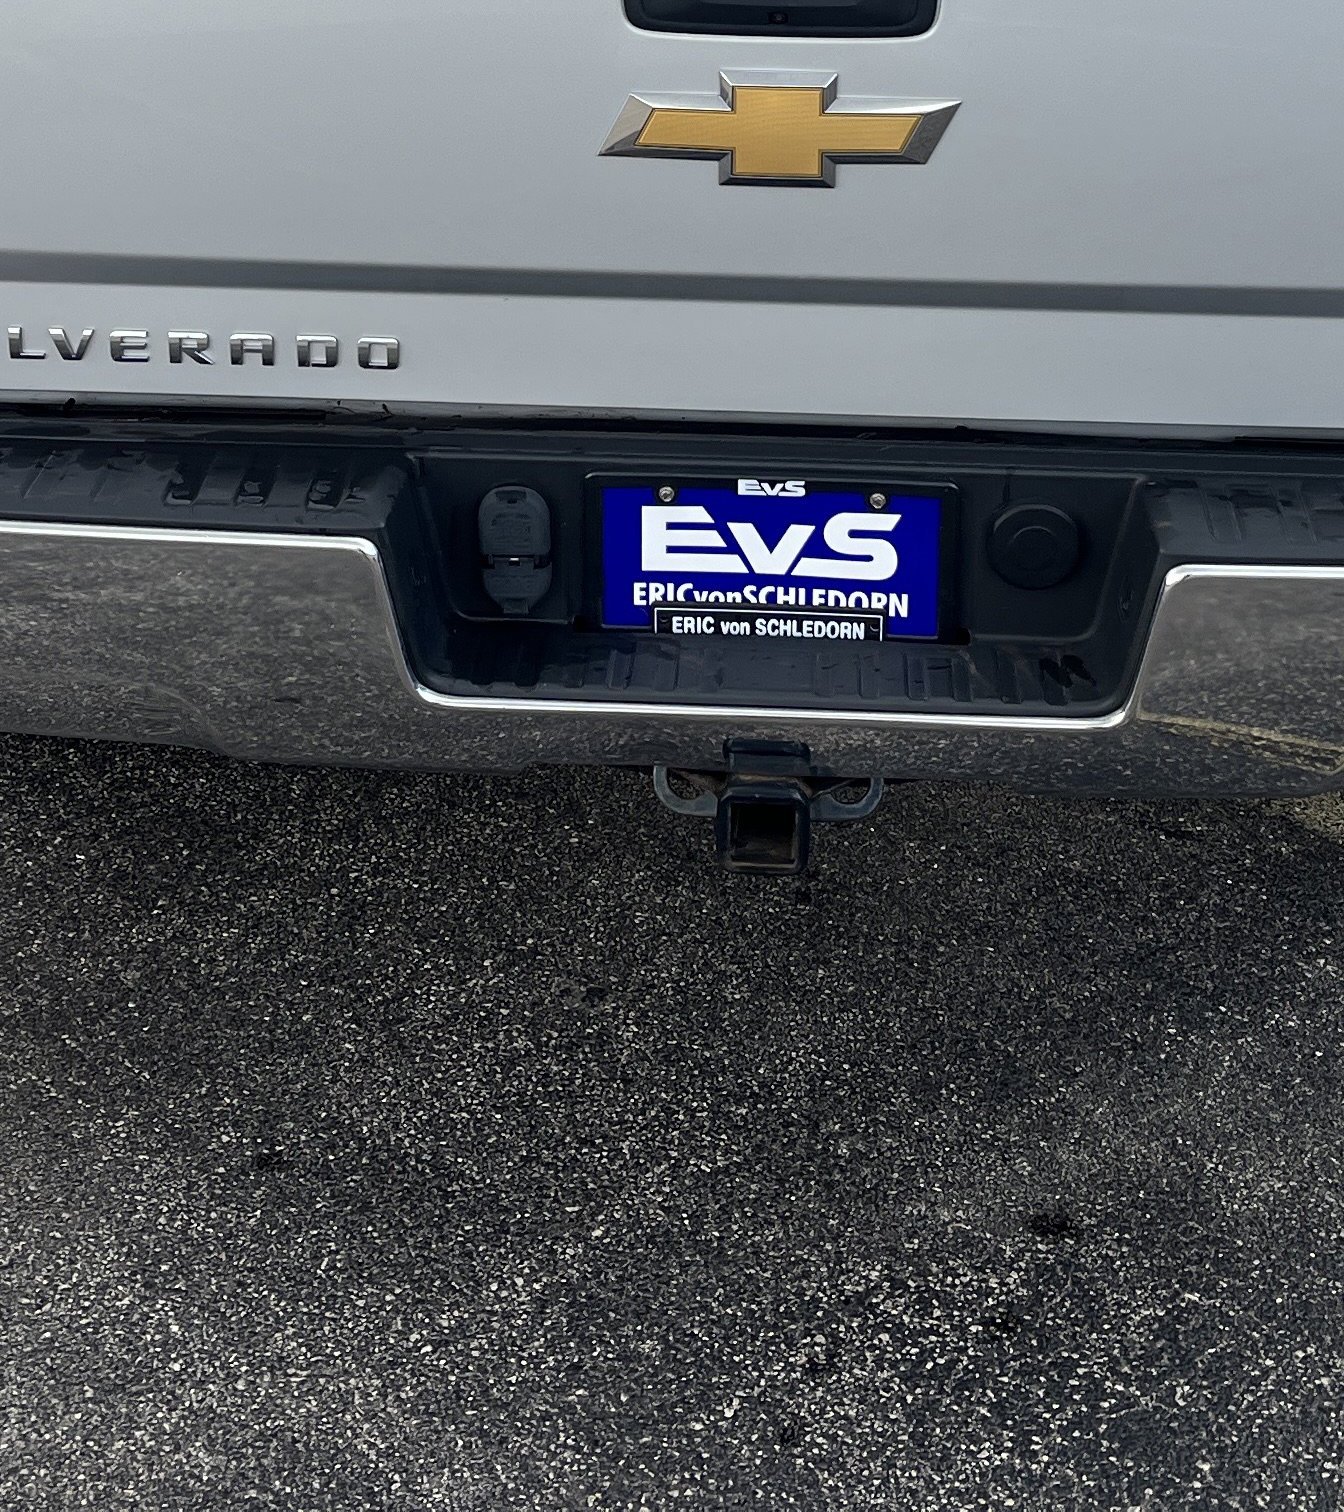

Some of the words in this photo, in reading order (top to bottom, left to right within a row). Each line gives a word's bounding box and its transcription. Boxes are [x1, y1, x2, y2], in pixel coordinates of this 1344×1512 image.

[671, 616, 715, 635] ERIC
[720, 620, 751, 635] von
[755, 618, 865, 640] SCHLEDORN
